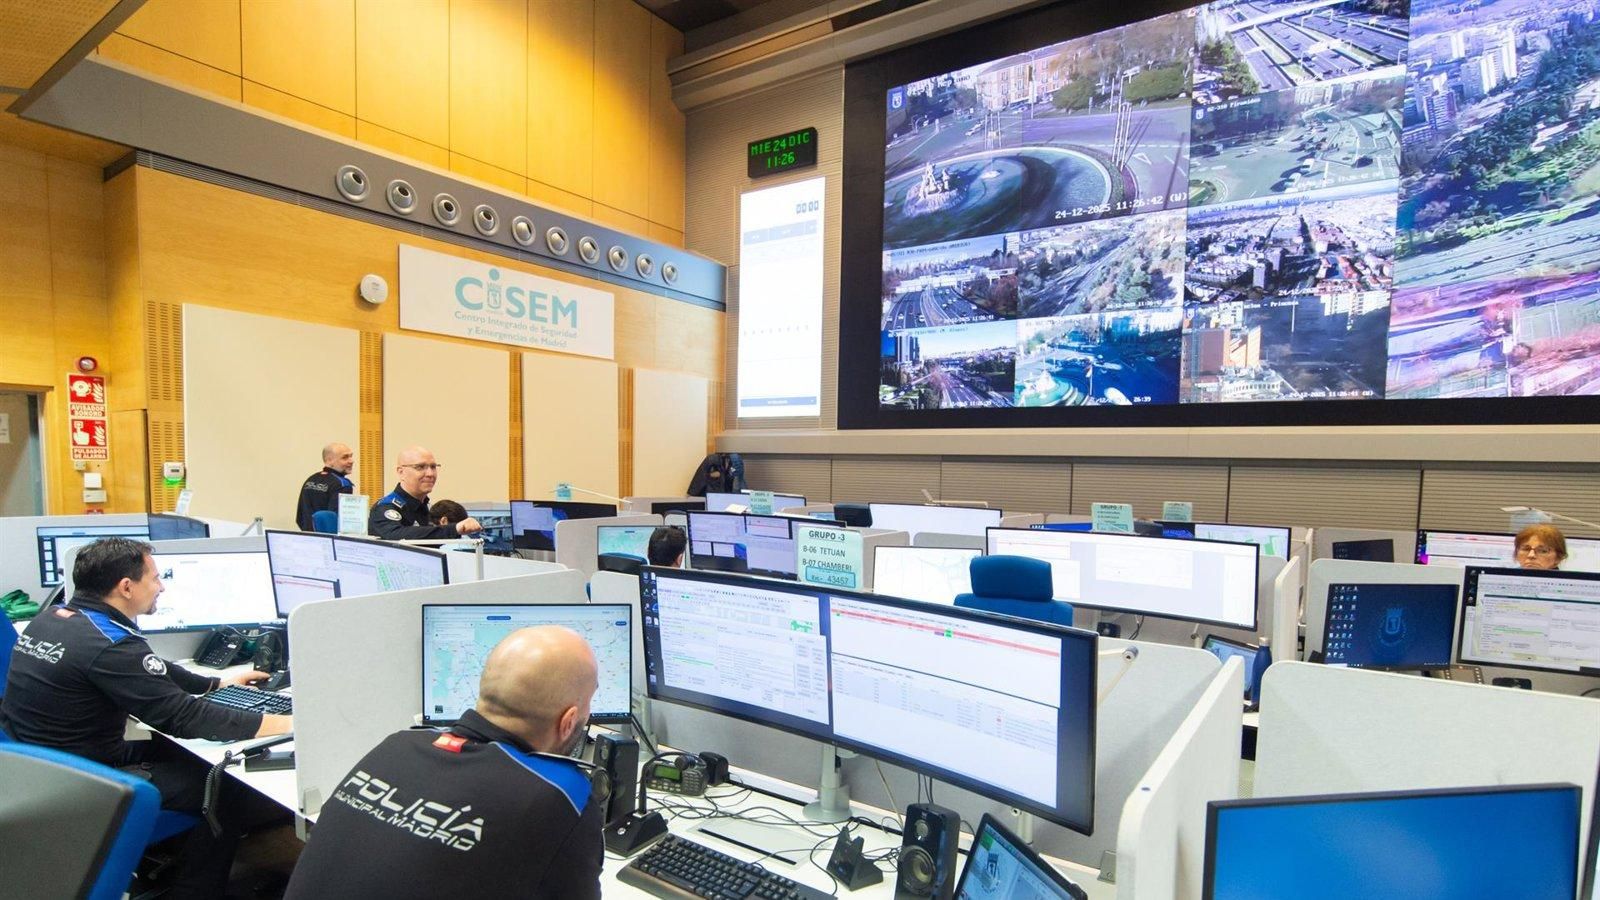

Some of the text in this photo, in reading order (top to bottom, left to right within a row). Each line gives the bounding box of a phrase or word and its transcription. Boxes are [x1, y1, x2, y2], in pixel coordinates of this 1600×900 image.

[751, 132, 810, 156] MIE 24 DIC
[767, 151, 795, 169] 11:26
[1055, 203, 1111, 219] 24-12-2025
[1116, 195, 1163, 210] 11:26:42
[454, 310, 577, 338] Centro Integrado de Seguridad
[467, 326, 567, 347] y Emergencias de Madrid
[71, 404, 104, 412] AVISADOR
[808, 530, 846, 541] GRUPO -3
[803, 545, 846, 557] B-06 TETUAN
[802, 558, 816, 567] B-07
[827, 576, 849, 584] 43457
[344, 770, 485, 842] POLICÍA
[334, 789, 476, 851] MUNICIPAL MADRID
